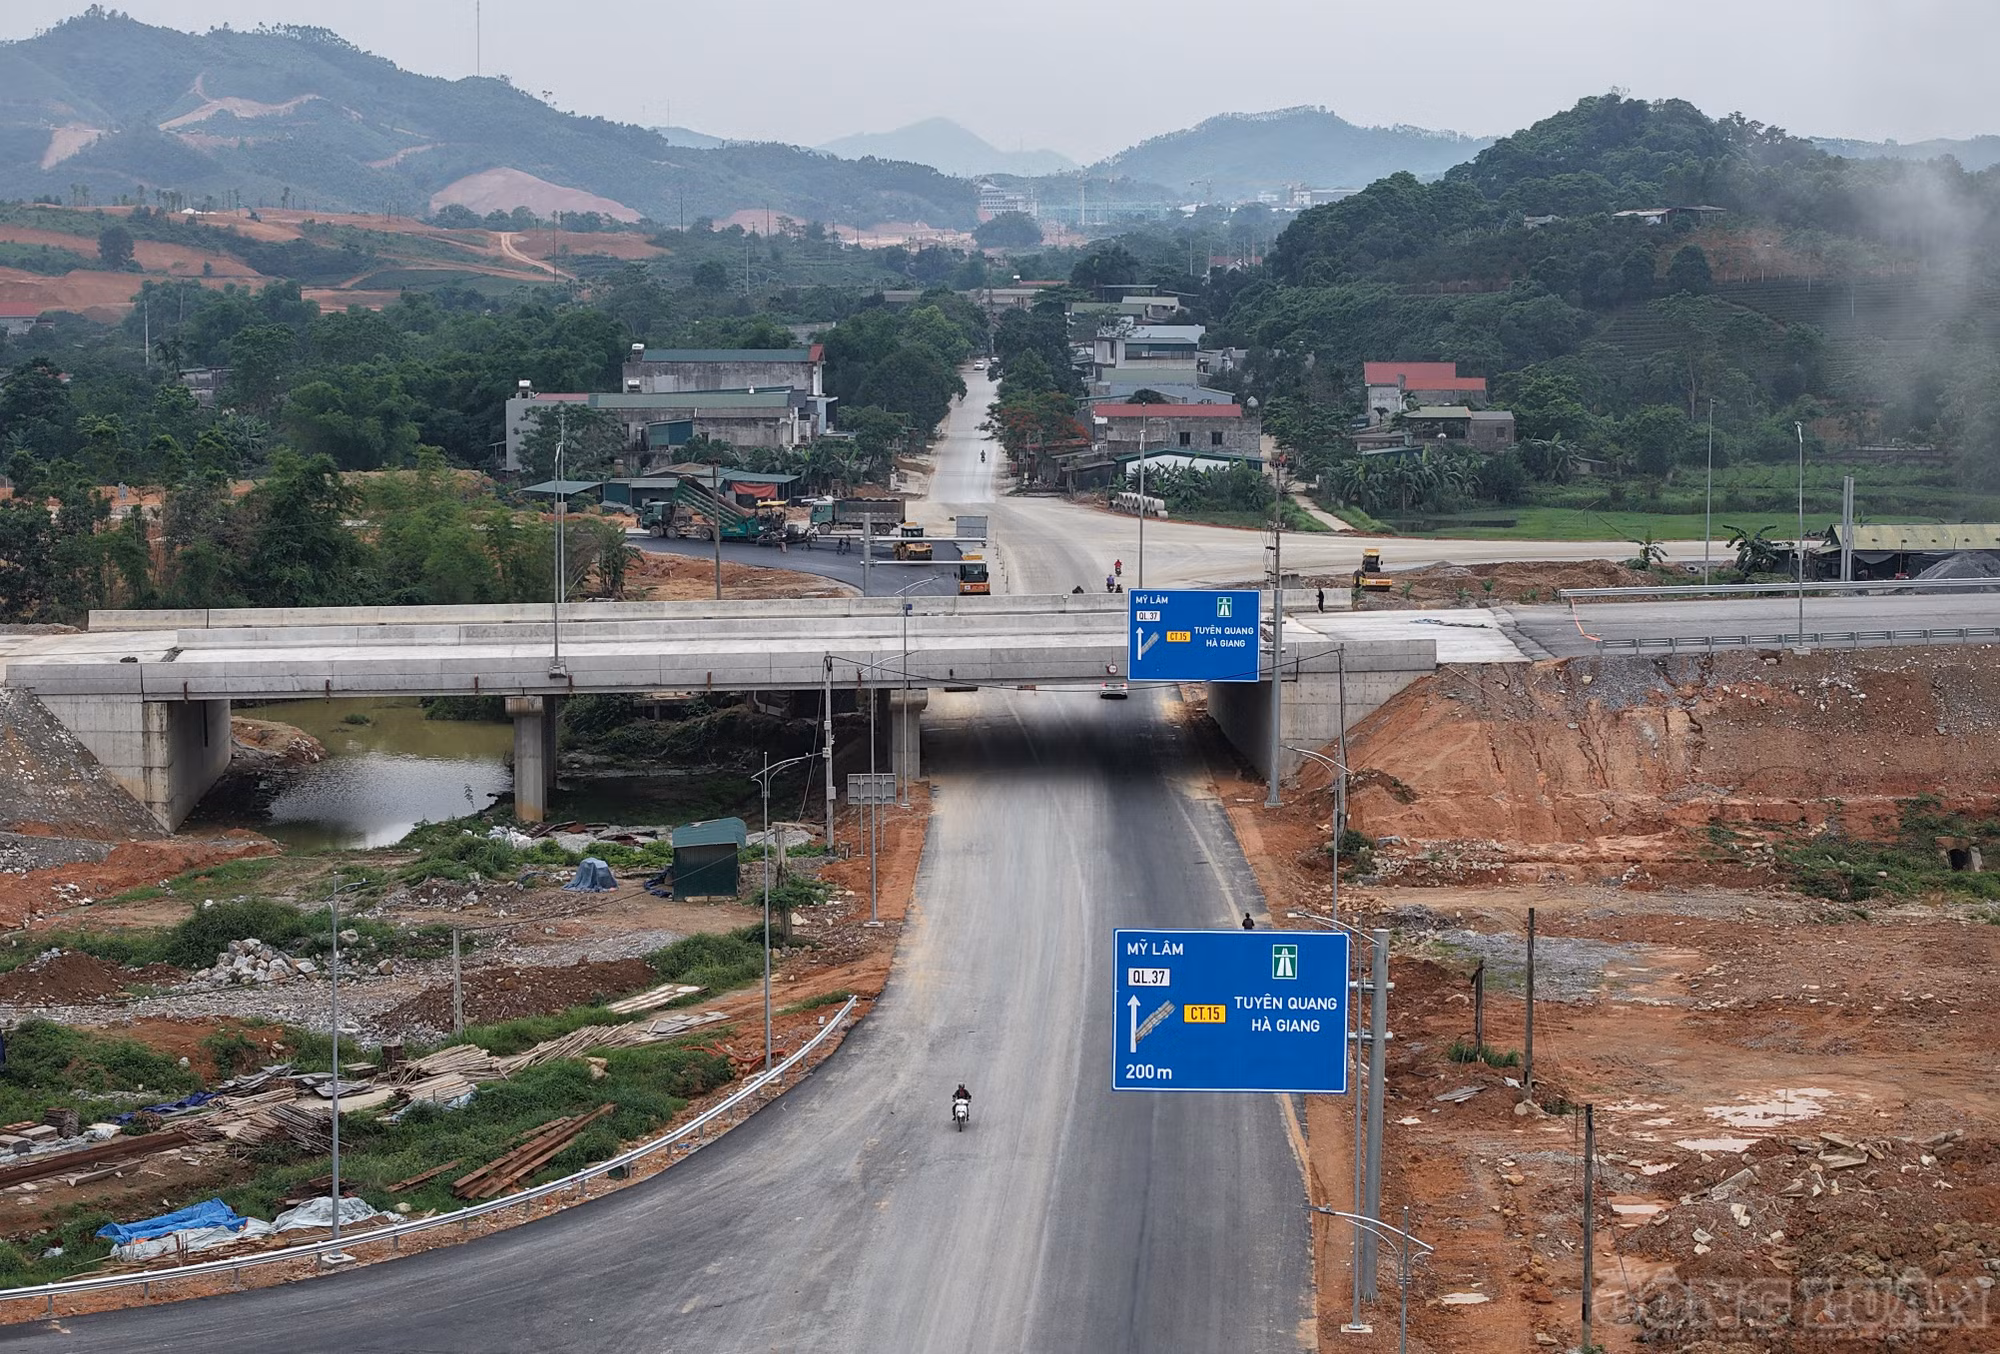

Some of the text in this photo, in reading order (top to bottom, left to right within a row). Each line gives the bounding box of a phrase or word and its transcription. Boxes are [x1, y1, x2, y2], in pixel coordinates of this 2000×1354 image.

[1136, 595, 1169, 604] MỸ LÂM
[1139, 612, 1157, 621] QL.37
[1194, 625, 1254, 635] TUYÊN QUANG
[1170, 633, 1187, 641] CT.15
[1206, 638, 1246, 648] HÀ GIANG
[1128, 939, 1183, 955] MỸ LÂM
[1133, 970, 1164, 984] QL.37
[1234, 993, 1337, 1010] TUYÊN QUANG
[1191, 1007, 1219, 1020] CT.15
[1252, 1016, 1320, 1032] HÀ GIANG
[1126, 1064, 1172, 1079] 200 m
